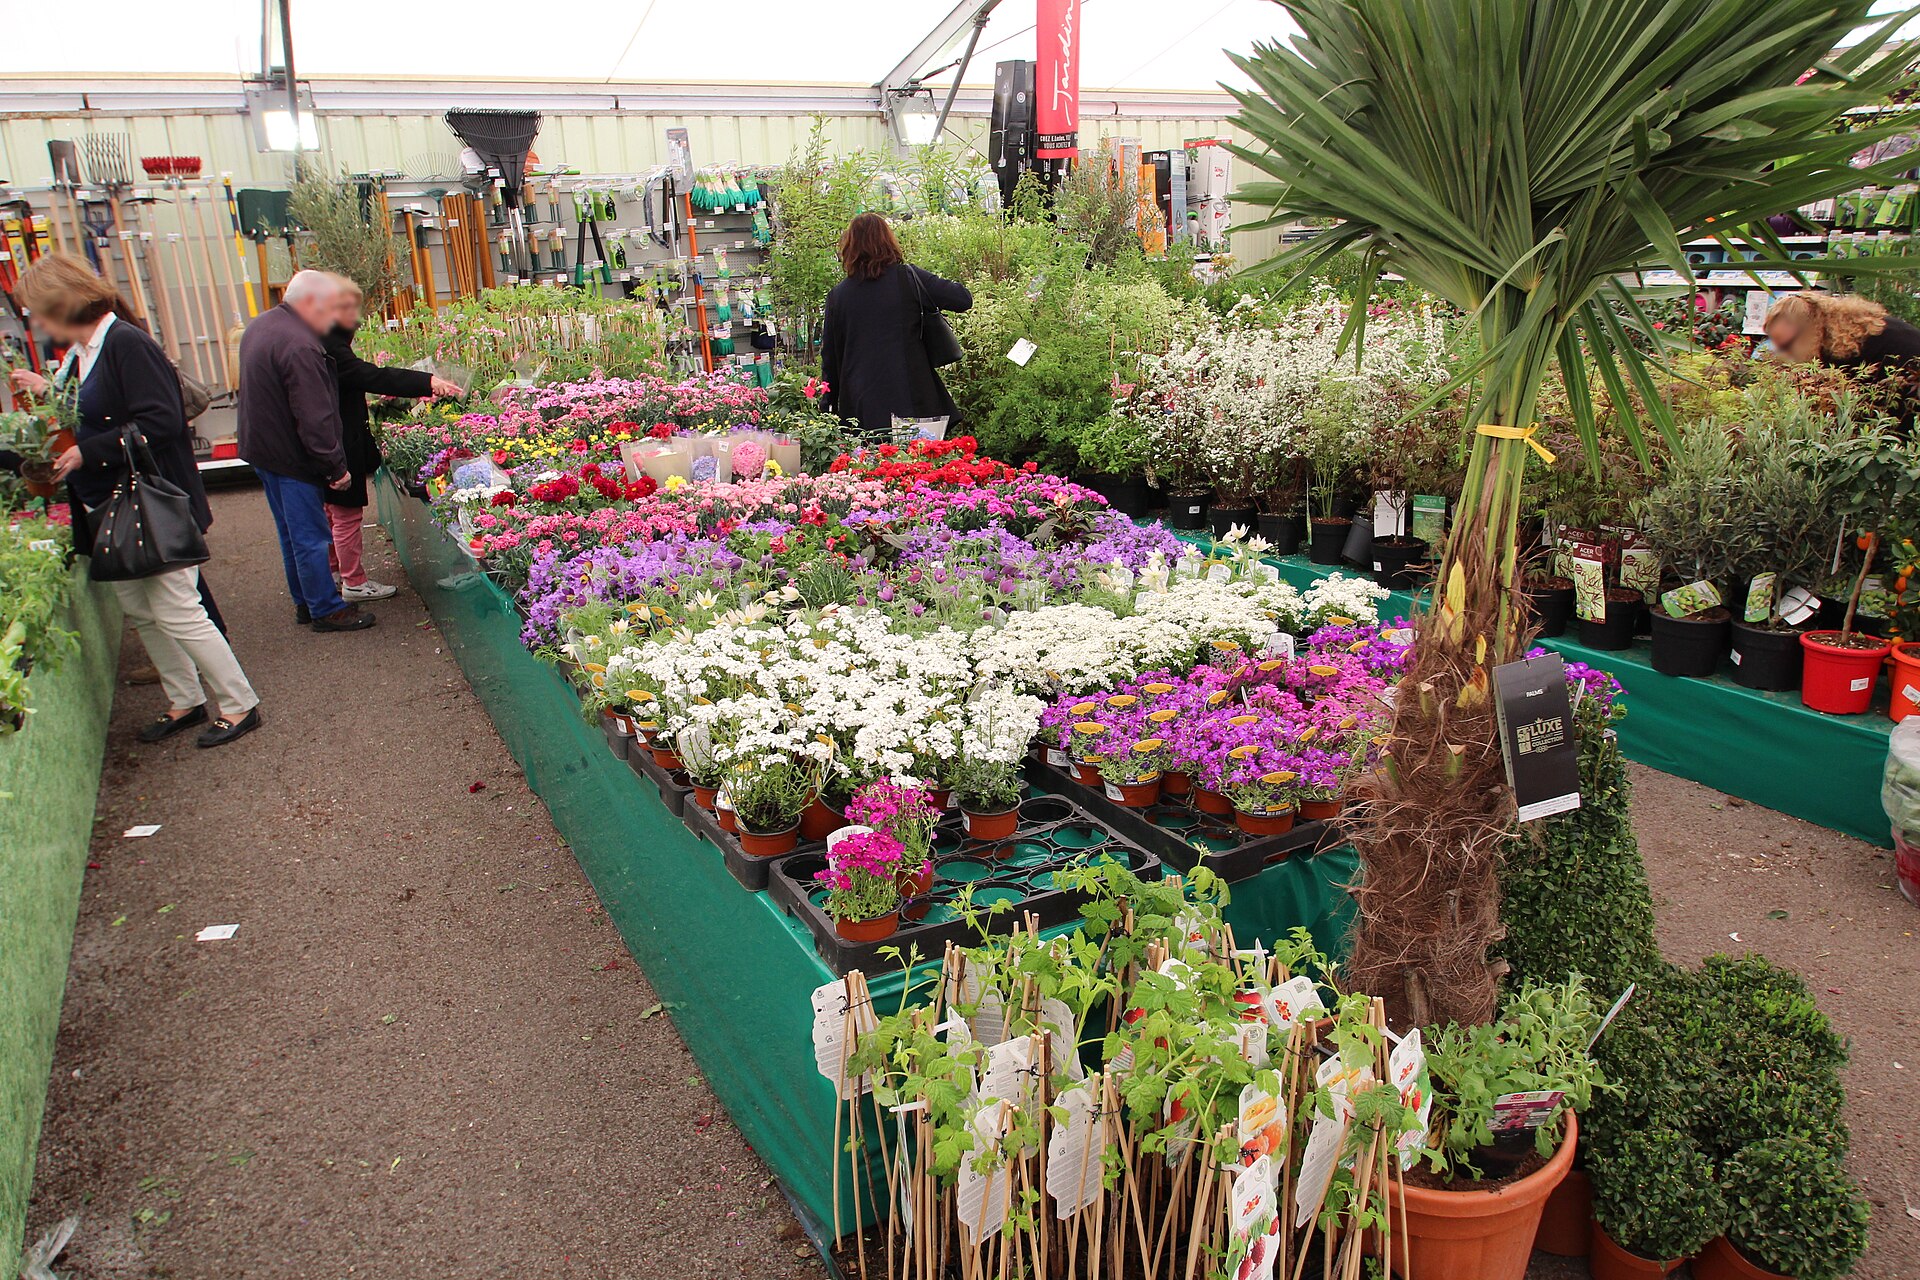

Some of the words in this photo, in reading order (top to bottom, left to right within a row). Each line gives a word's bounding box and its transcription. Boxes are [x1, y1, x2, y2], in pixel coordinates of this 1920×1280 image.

[1579, 547, 1594, 555] ACER
[1530, 719, 1563, 736] LUXE
[1532, 735, 1564, 747] COLLECTION
